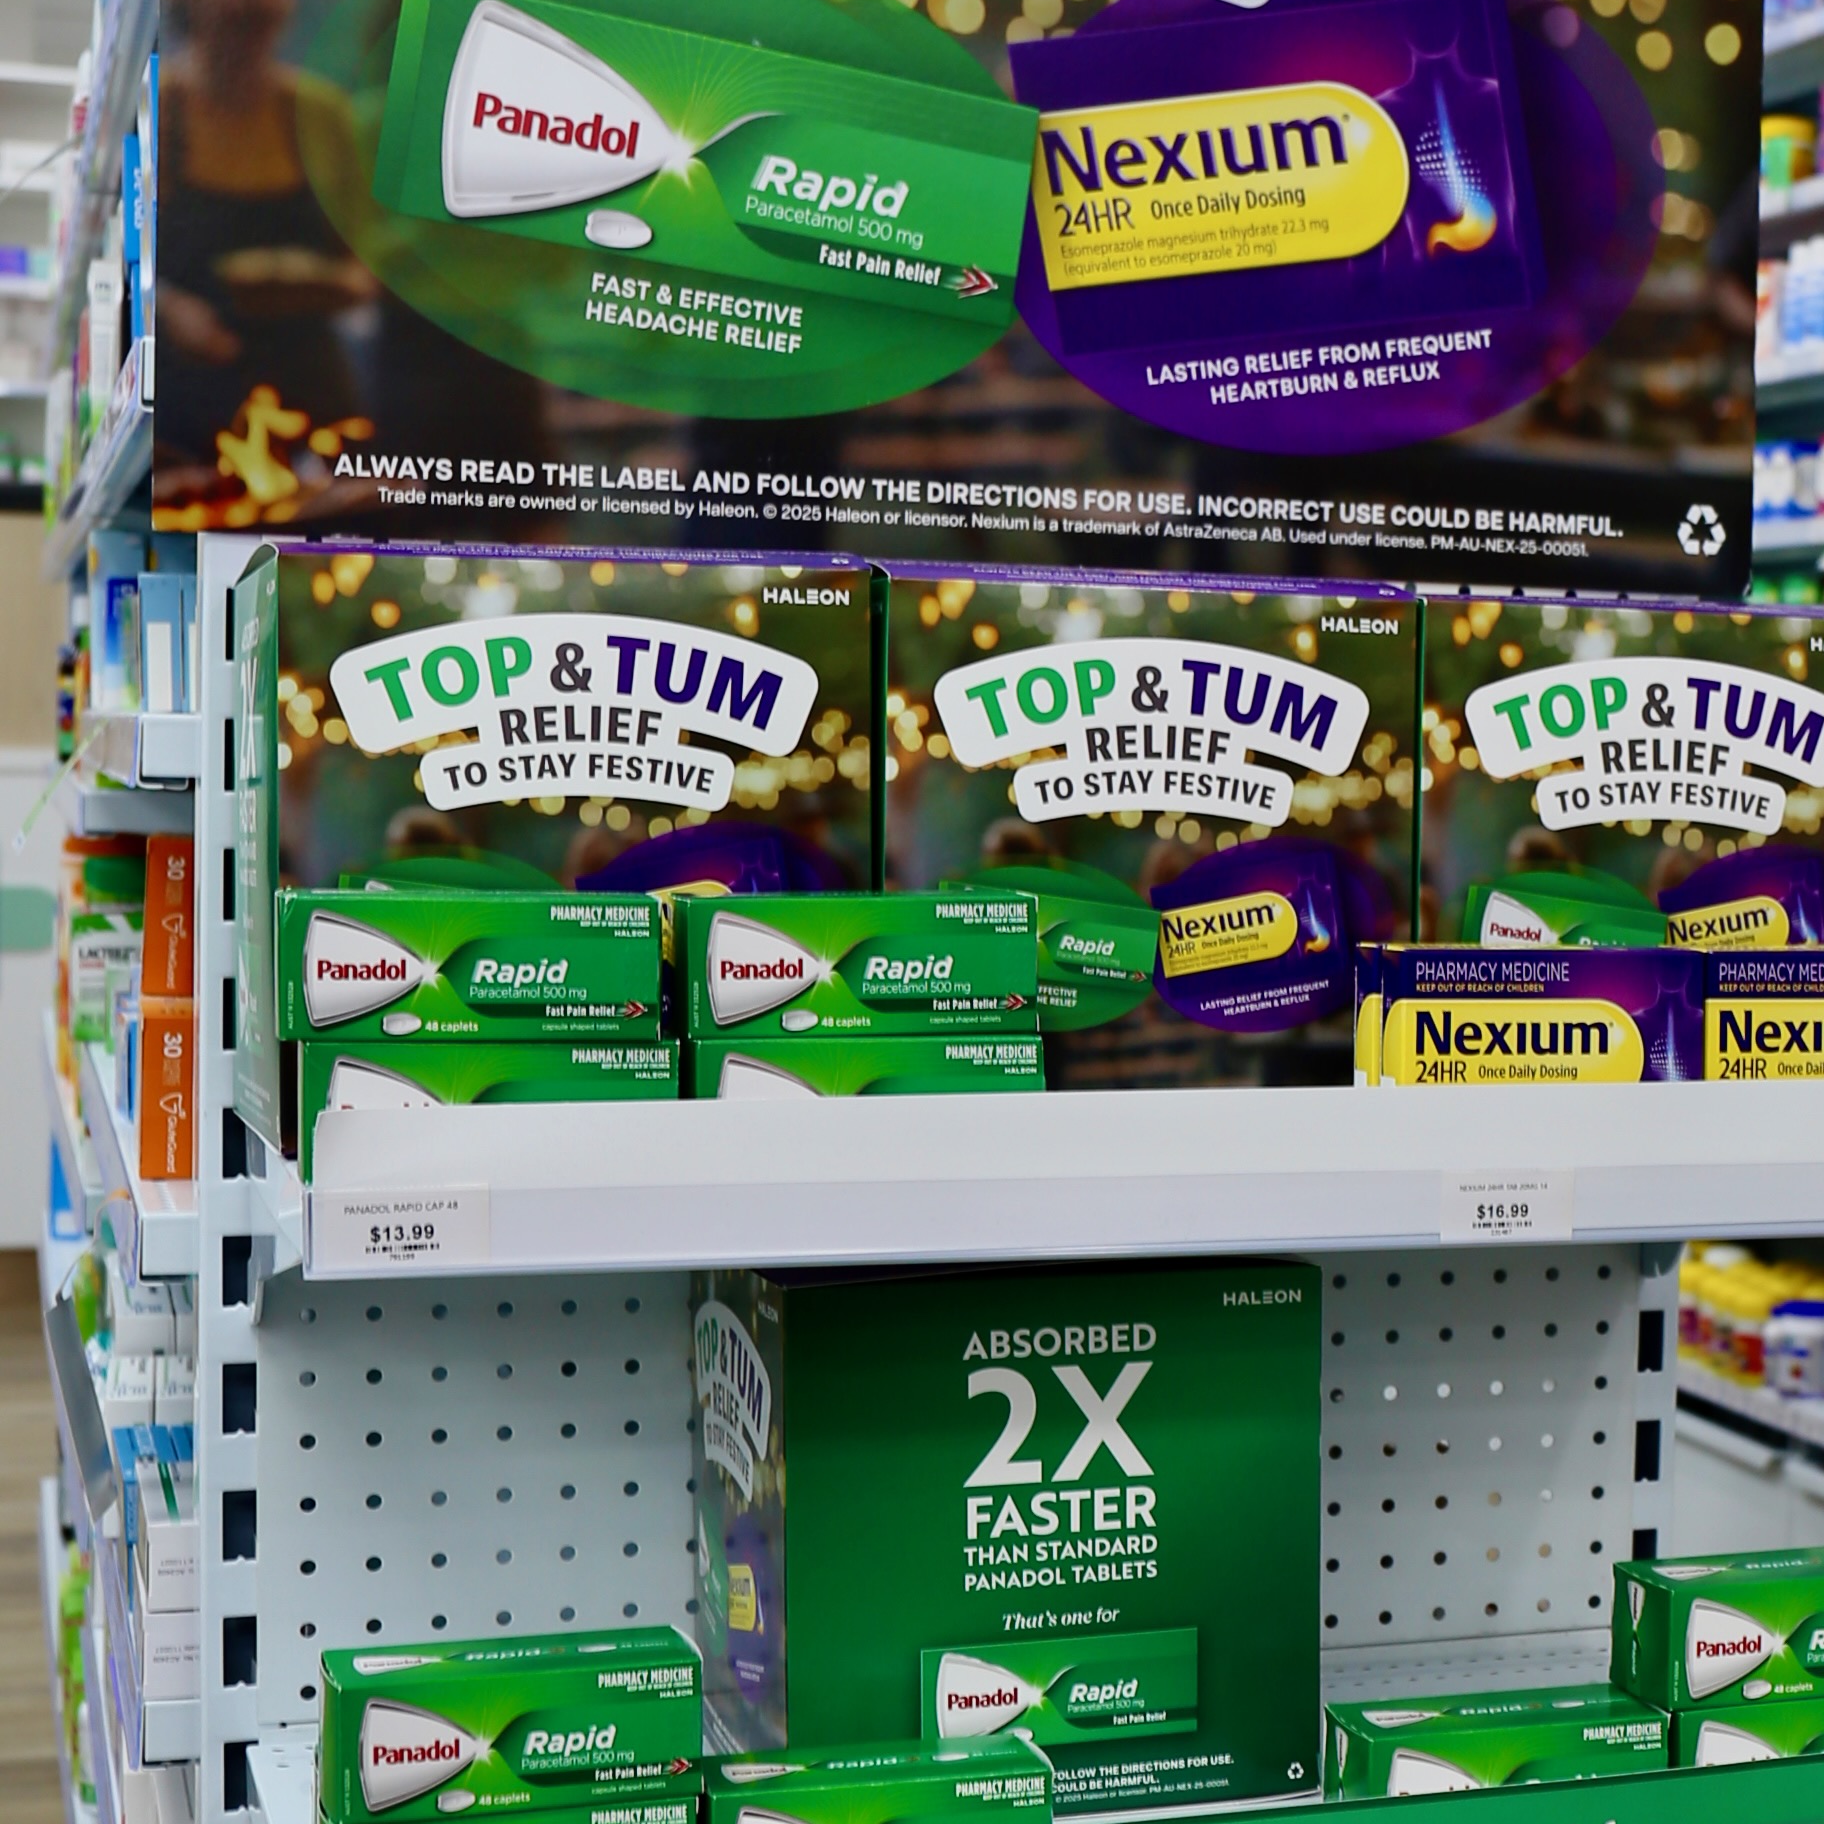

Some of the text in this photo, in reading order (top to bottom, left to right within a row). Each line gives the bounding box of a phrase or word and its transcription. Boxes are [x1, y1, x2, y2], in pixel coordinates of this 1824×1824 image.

[473, 92, 640, 159] Panadol
[1038, 113, 1349, 198] Nexium
[754, 155, 909, 218] Rapid
[745, 196, 923, 250] Paracetamol 500 mg
[1053, 185, 1305, 238] 24HR Once Daily Dosing
[1060, 235, 1143, 260] Esomeprazole
[1147, 229, 1217, 252] magnesium
[1220, 220, 1278, 246] trihydrate
[1310, 217, 1329, 233] mg
[819, 243, 941, 287] Fast Pain Relief
[591, 273, 803, 328] FAST & EFFECTIVE
[585, 300, 802, 354] HEADACHE RELIEF
[1146, 329, 1493, 386] LASTING RELIEF FROM FREQUENT
[1210, 361, 1440, 405] HEARTBURN & REFLUX
[334, 453, 1623, 537] ALWAYS READ THE LABEL AND FOLLOW THE DIRECTIONS FOR USE. INCORRECT USE COULD BE HARMFUL.
[377, 486, 426, 505] Trade
[430, 489, 484, 508] marks
[489, 494, 515, 508] are
[520, 492, 576, 512] owned
[581, 499, 598, 513] or
[602, 496, 670, 516] licensed
[675, 499, 695, 519] by
[699, 501, 759, 519] Haleon.
[762, 504, 777, 520] ©
[781, 504, 822, 521] 2025
[826, 506, 880, 524] Haleon
[884, 512, 900, 525] or
[904, 510, 968, 528] licensor.
[971, 513, 1030, 531] Nexium
[1034, 515, 1046, 531] is
[1050, 521, 1059, 532] a
[1062, 517, 1140, 536] trademark
[1144, 521, 1160, 536] of
[1164, 522, 1257, 541] AstraZeneca
[1261, 528, 1286, 543] AB.
[1290, 529, 1325, 544] Used
[1329, 530, 1371, 547] under
[1375, 532, 1428, 549] license.
[364, 635, 783, 731] TOP & TUM
[500, 705, 662, 748] RELIEF
[443, 754, 715, 794] TO STAY FESTIVE
[550, 906, 650, 921] PHARMACY MEDICINE
[317, 958, 406, 982] Panadol
[473, 958, 569, 987] Rapid
[1415, 1011, 1608, 1056] Nexium
[370, 1225, 434, 1243] $13.99
[1477, 1204, 1529, 1220] $16.99
[1223, 1288, 1302, 1307] HALEON
[963, 1323, 1157, 1360] ABSORBED
[963, 1361, 1156, 1487] 2X
[966, 1487, 1157, 1540] FASTER
[963, 1534, 1158, 1567] THAN STANDARD
[964, 1560, 1158, 1592] PANADOL TABLETS
[1061, 1608, 1093, 1626] one
[1096, 1606, 1119, 1625] for
